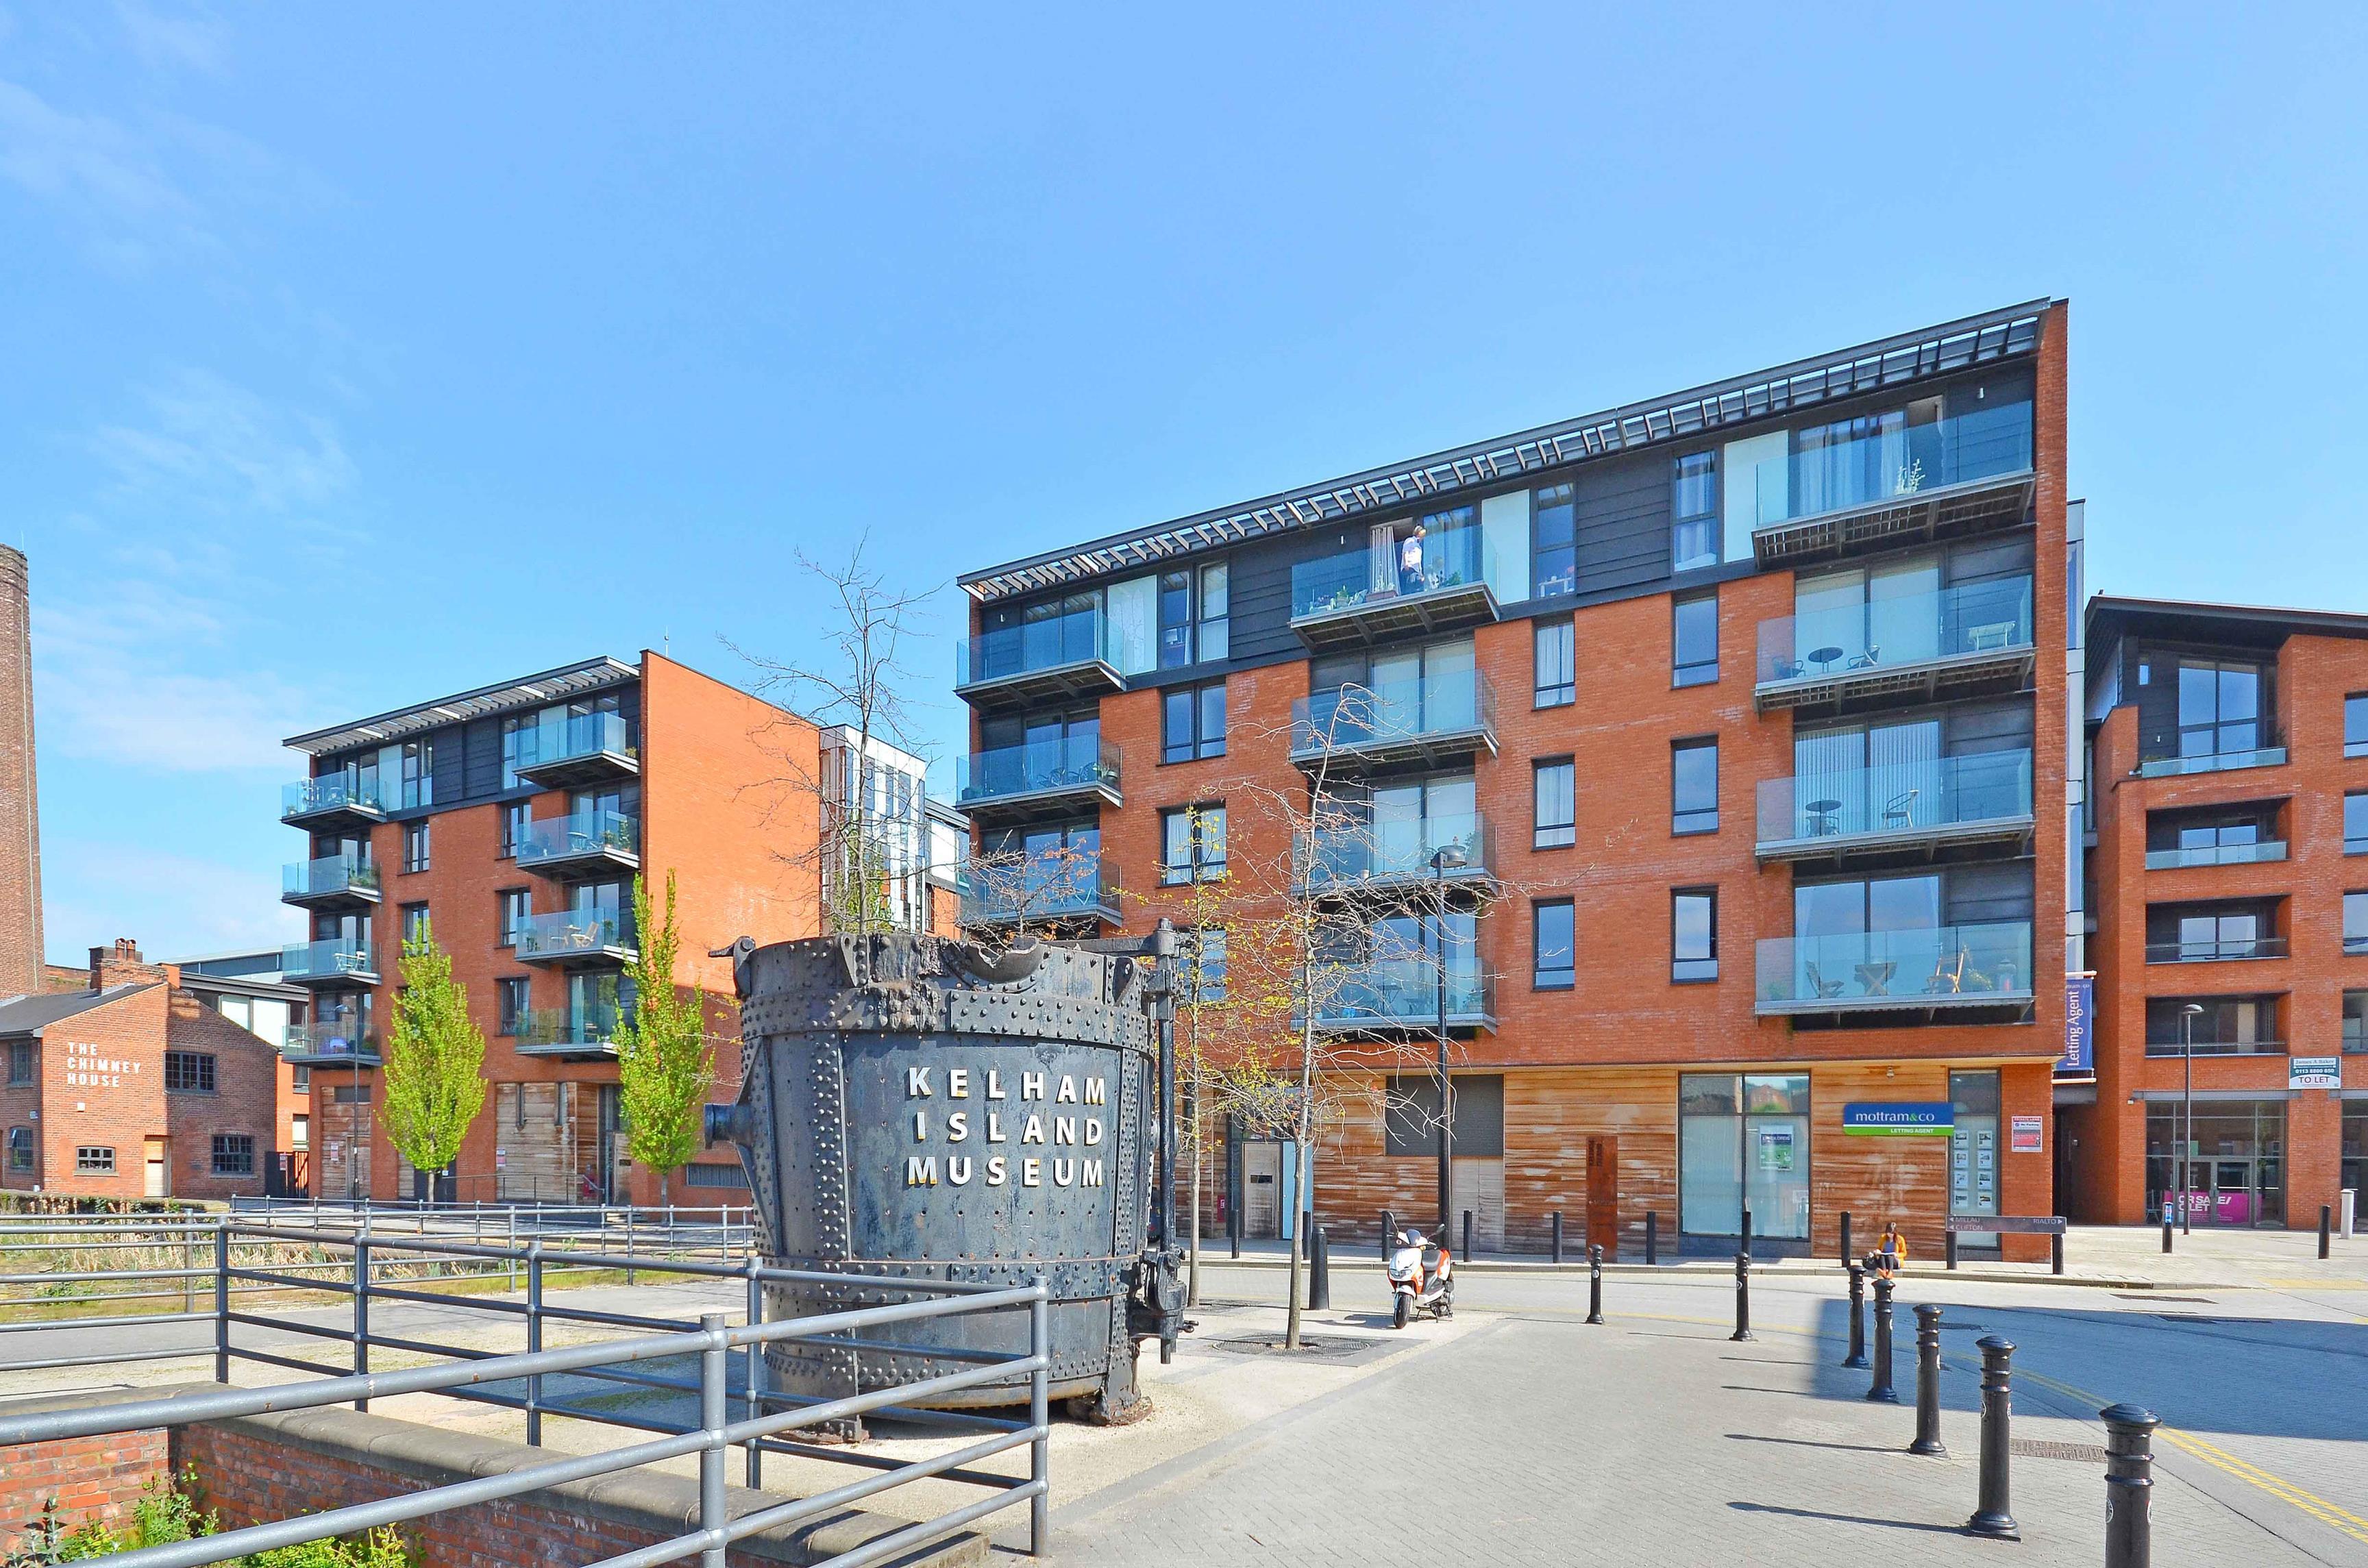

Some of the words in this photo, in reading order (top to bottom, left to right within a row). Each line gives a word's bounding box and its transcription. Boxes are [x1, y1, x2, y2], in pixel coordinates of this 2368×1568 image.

[2067, 991, 2083, 1025] Agent
[67, 1041, 98, 1056] THE
[2067, 1027, 2083, 1067] Letting
[67, 1056, 141, 1074] CHIMNEY
[66, 1072, 121, 1088] HOUSE
[908, 1067, 1106, 1104] KELHAM
[915, 1111, 1103, 1145] ISLAND
[1855, 1111, 1935, 1122] mottram&co
[908, 1156, 1103, 1186] MUSEUM
[2189, 1204, 2210, 1212] LET
